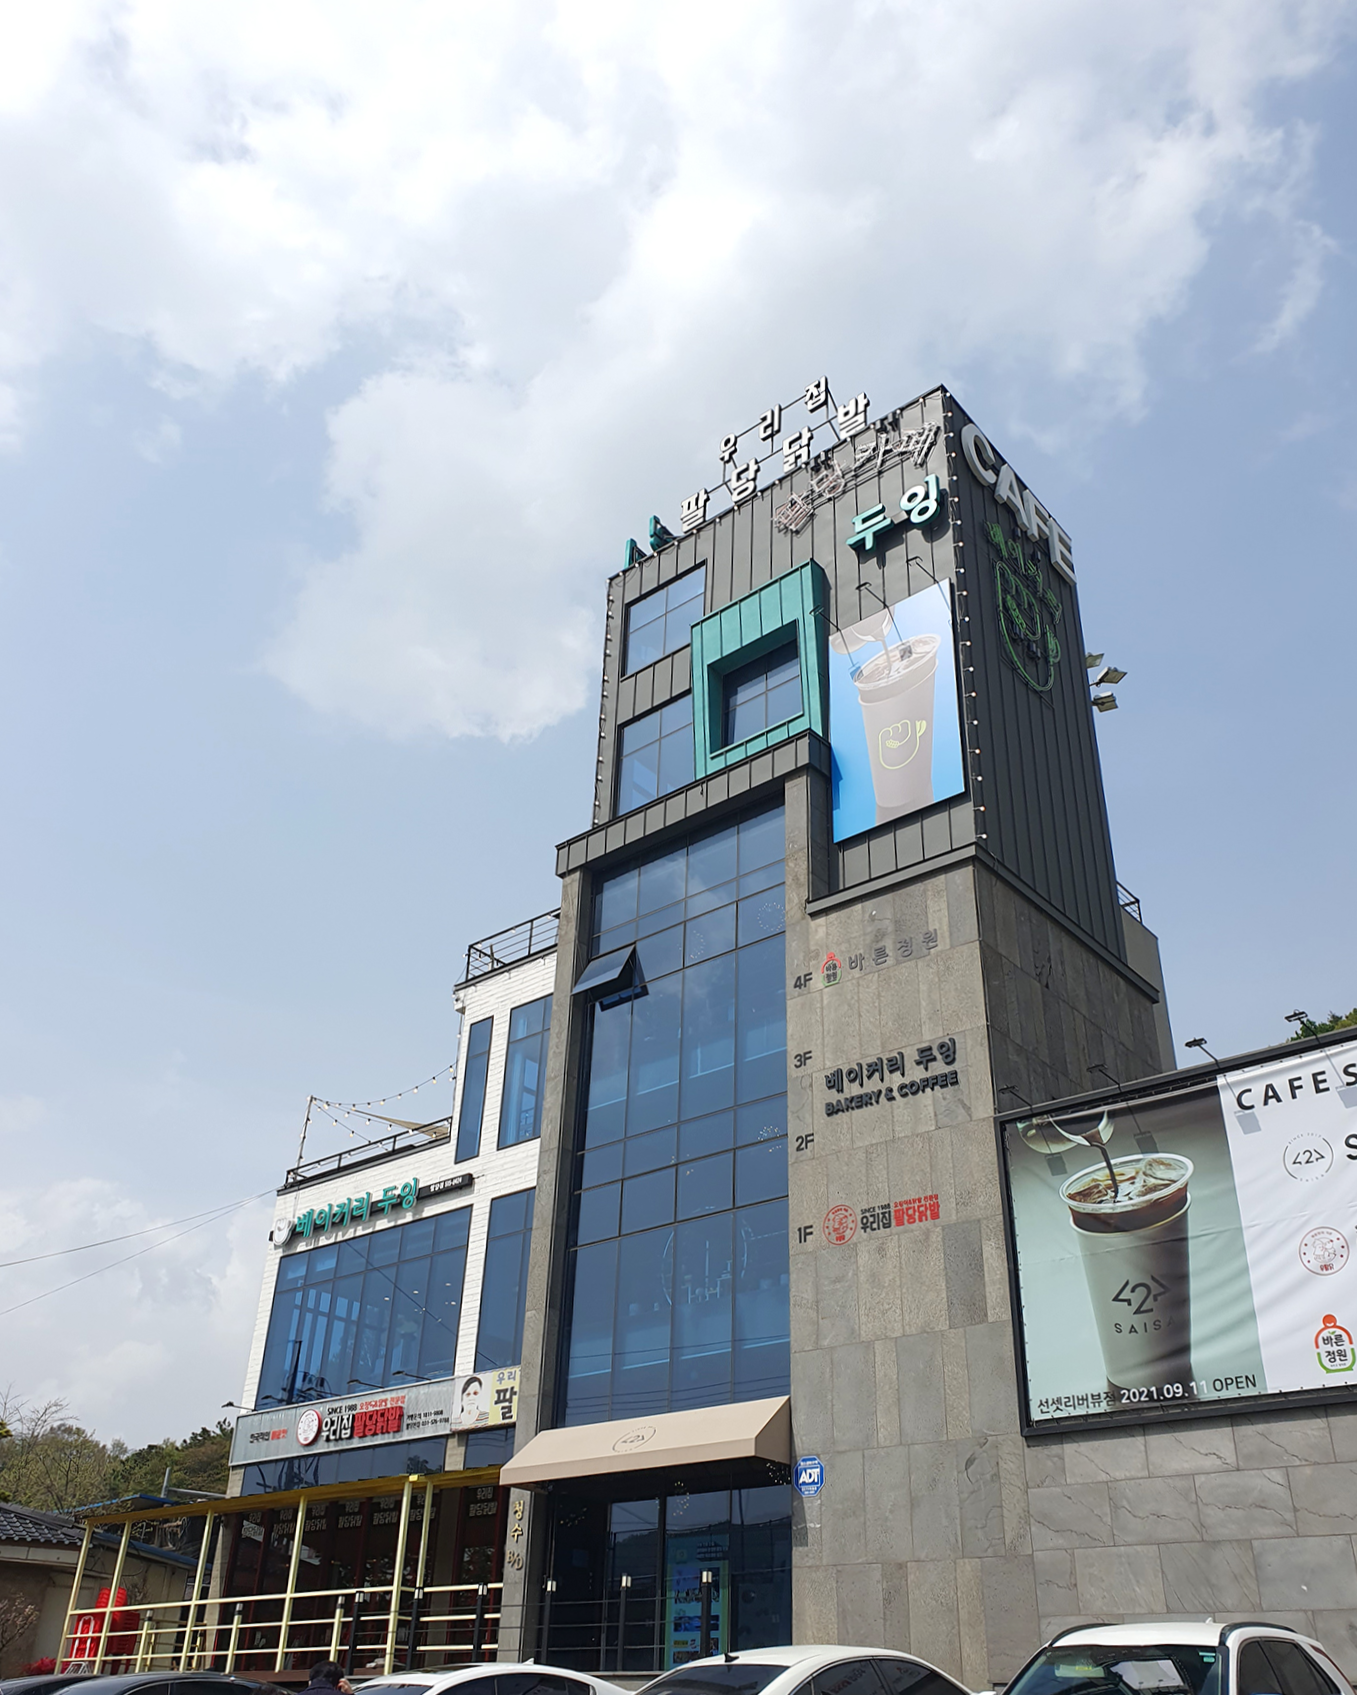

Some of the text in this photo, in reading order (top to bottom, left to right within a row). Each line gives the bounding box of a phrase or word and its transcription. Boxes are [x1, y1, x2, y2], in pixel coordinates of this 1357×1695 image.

[719, 375, 828, 463] 우리집
[680, 391, 870, 534] 팔당닭발
[845, 473, 941, 551] 두잉
[961, 423, 1077, 586] CAFE
[793, 971, 813, 990] 4F
[793, 1050, 813, 1069] 3F
[824, 1037, 958, 1094] 베이커리 두잉
[824, 1069, 960, 1118] BAKERY & COFFEE
[1236, 1070, 1330, 1111] CAFE
[795, 1132, 815, 1152] 2F
[295, 1177, 420, 1238] 베이커리 두잉
[860, 1205, 876, 1215] SINCE
[893, 1200, 940, 1227] 팔당닭발
[796, 1224, 814, 1244] 1F
[860, 1210, 892, 1234] 우리집
[1321, 1333, 1345, 1348] 바른
[1324, 1348, 1348, 1364] 정원
[496, 1369, 520, 1386] 우리
[1037, 1373, 1257, 1415] 선셋리버뷰점 2021.09.11 OPEN
[327, 1404, 343, 1416] SINCE
[353, 1405, 404, 1438] 팔당닭발
[320, 1413, 353, 1441] 우리집
[799, 1468, 820, 1484] ADT
[477, 1487, 494, 1500] 우리집
